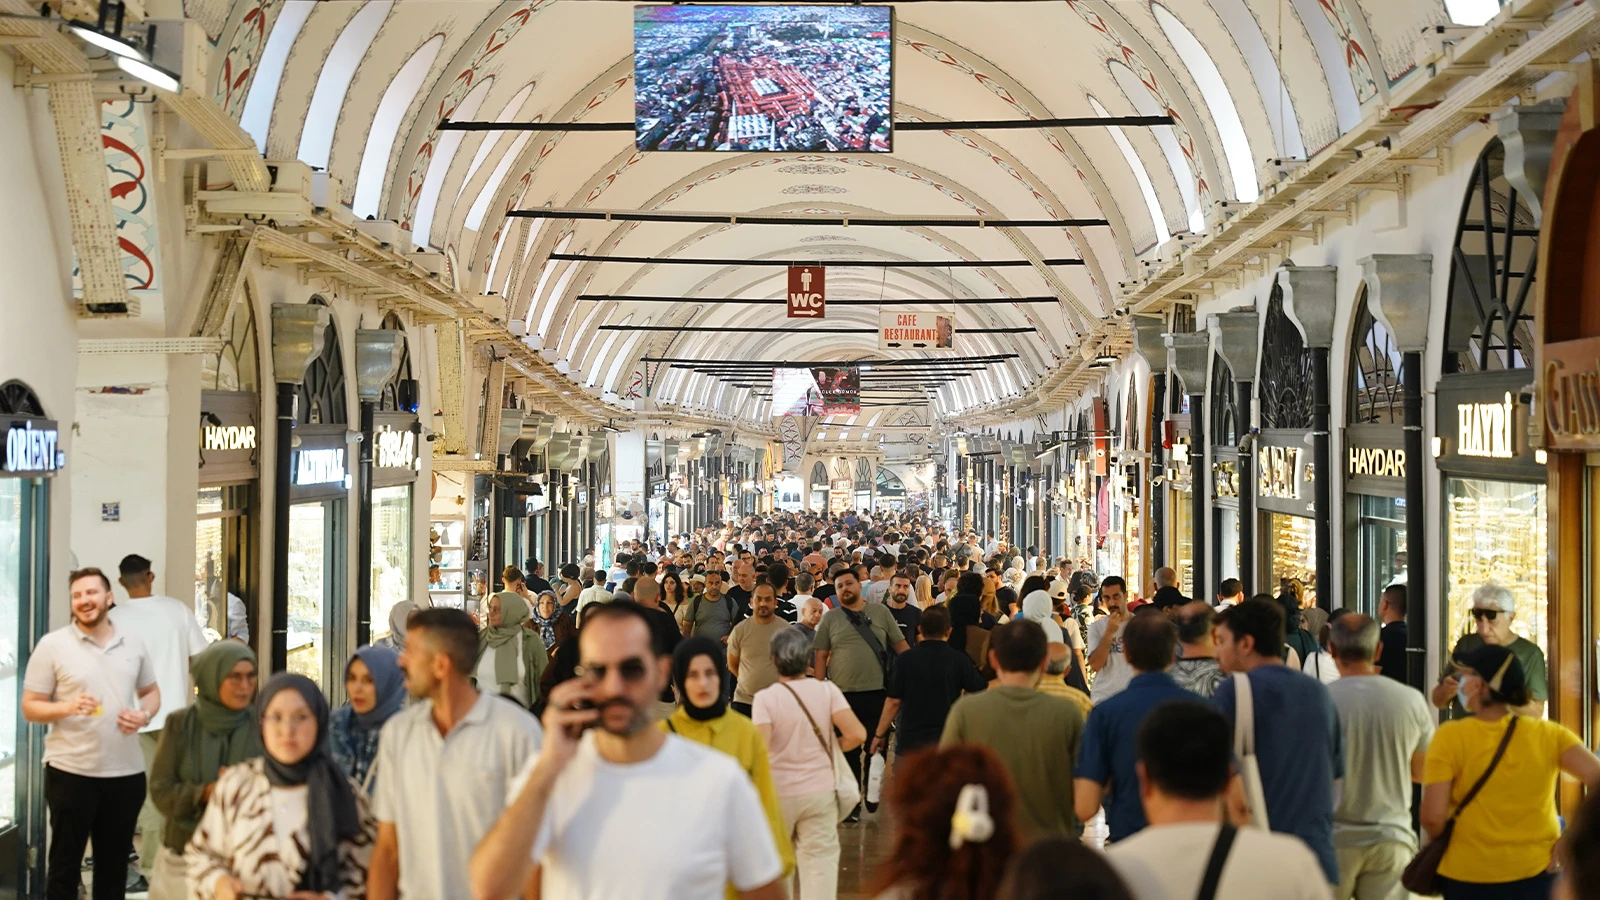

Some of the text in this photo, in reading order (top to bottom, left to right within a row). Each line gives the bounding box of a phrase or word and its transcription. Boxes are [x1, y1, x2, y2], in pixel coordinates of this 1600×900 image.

[790, 293, 823, 308] WC
[897, 314, 917, 327] CAFE
[884, 328, 937, 341] RESTAURANT
[1457, 390, 1513, 459] HAYRİ
[6, 419, 58, 472] ORİENT
[205, 425, 256, 451] HAYDAR
[1349, 447, 1406, 478] HAYDAR
